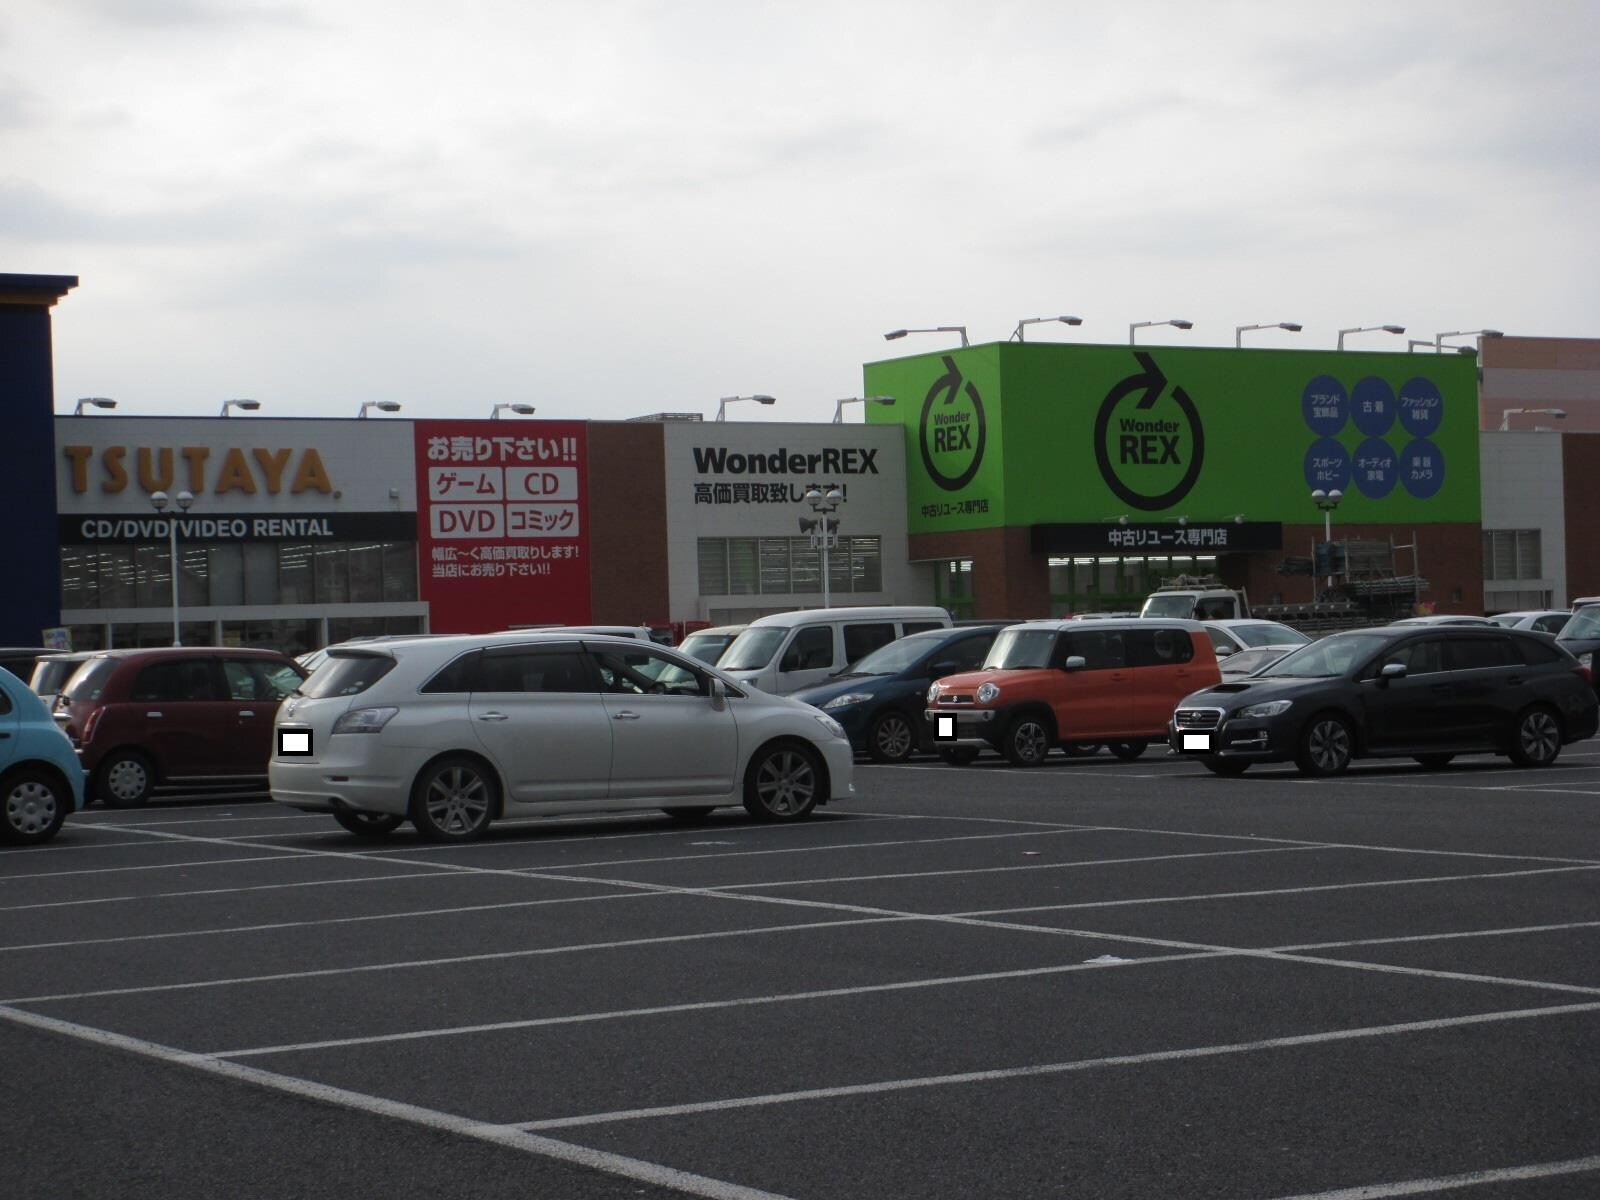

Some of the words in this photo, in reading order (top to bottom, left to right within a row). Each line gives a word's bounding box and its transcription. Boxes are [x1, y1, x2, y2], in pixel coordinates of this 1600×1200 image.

[934, 411, 971, 426] Wonder
[1119, 418, 1180, 433] Wonder
[427, 436, 577, 462] お売り下さい!!
[934, 424, 972, 453] REX
[1119, 435, 1181, 465] REX
[692, 448, 879, 475] WonderREX
[436, 472, 496, 495] ゲーム
[524, 472, 559, 495] CD
[921, 499, 989, 518] 中古リユース専門店
[253, 518, 333, 538] RENTAL
[439, 510, 496, 533] DVD
[511, 510, 574, 531] コミック
[1108, 528, 1228, 546] 中古リユース専門店
[432, 563, 551, 578] 当店にお売り下さい!!
